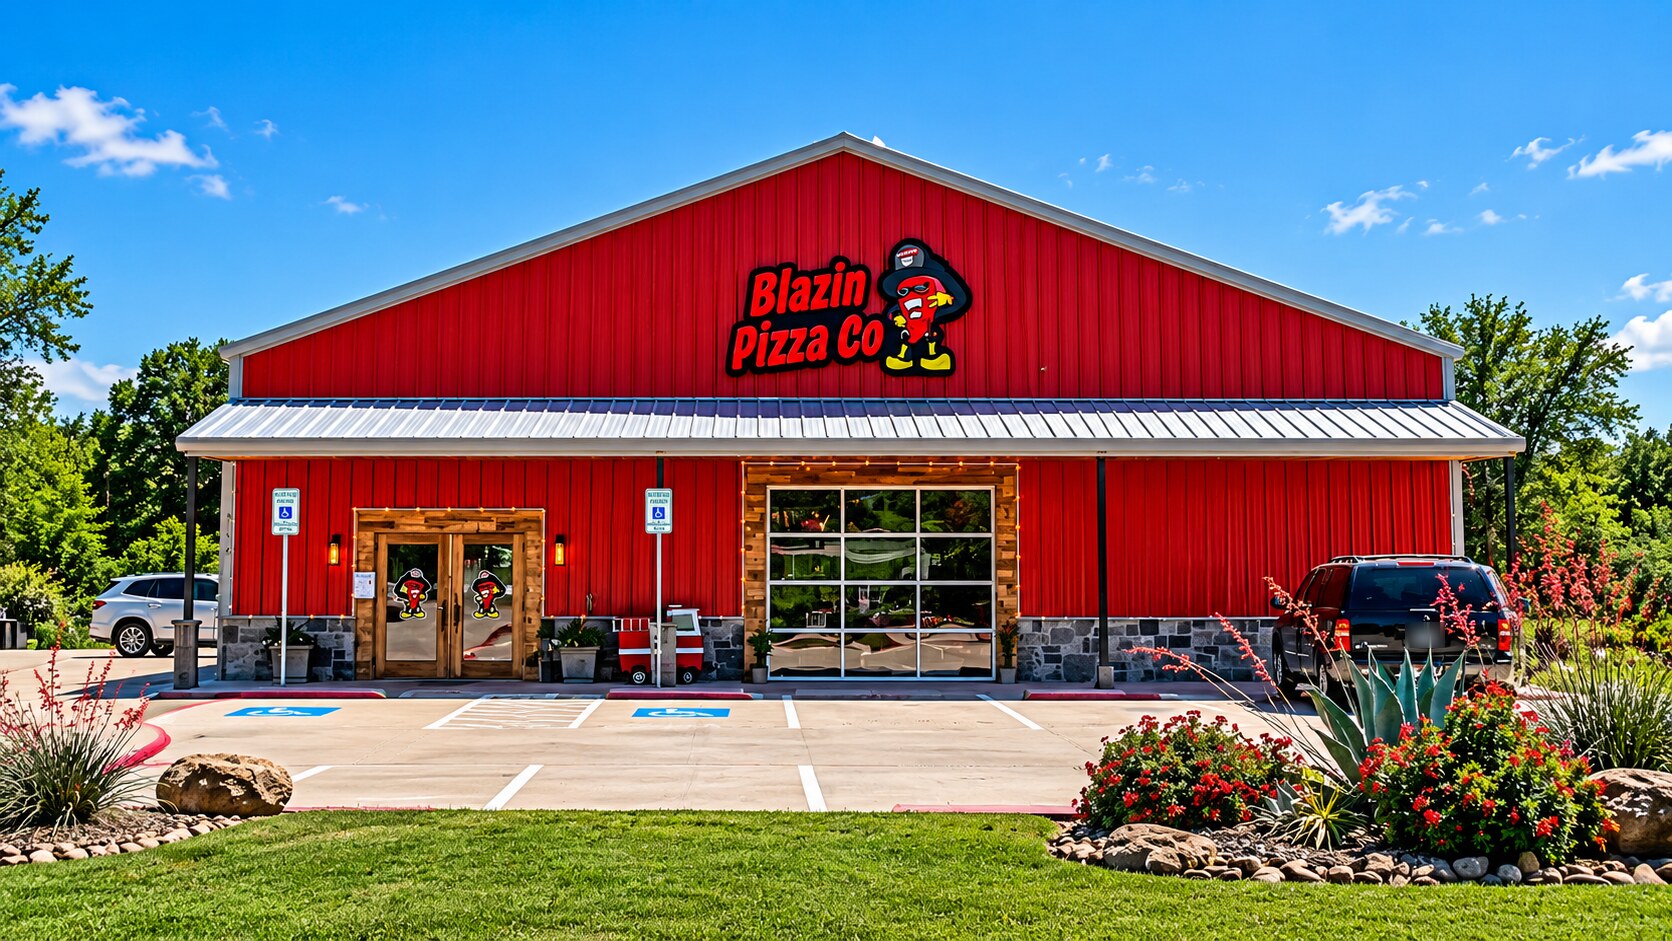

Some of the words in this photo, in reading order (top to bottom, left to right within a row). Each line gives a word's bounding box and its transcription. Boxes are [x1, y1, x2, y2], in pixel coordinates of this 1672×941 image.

[750, 261, 867, 317] Blazin
[731, 320, 829, 371] Pizza
[837, 314, 885, 359] Co
